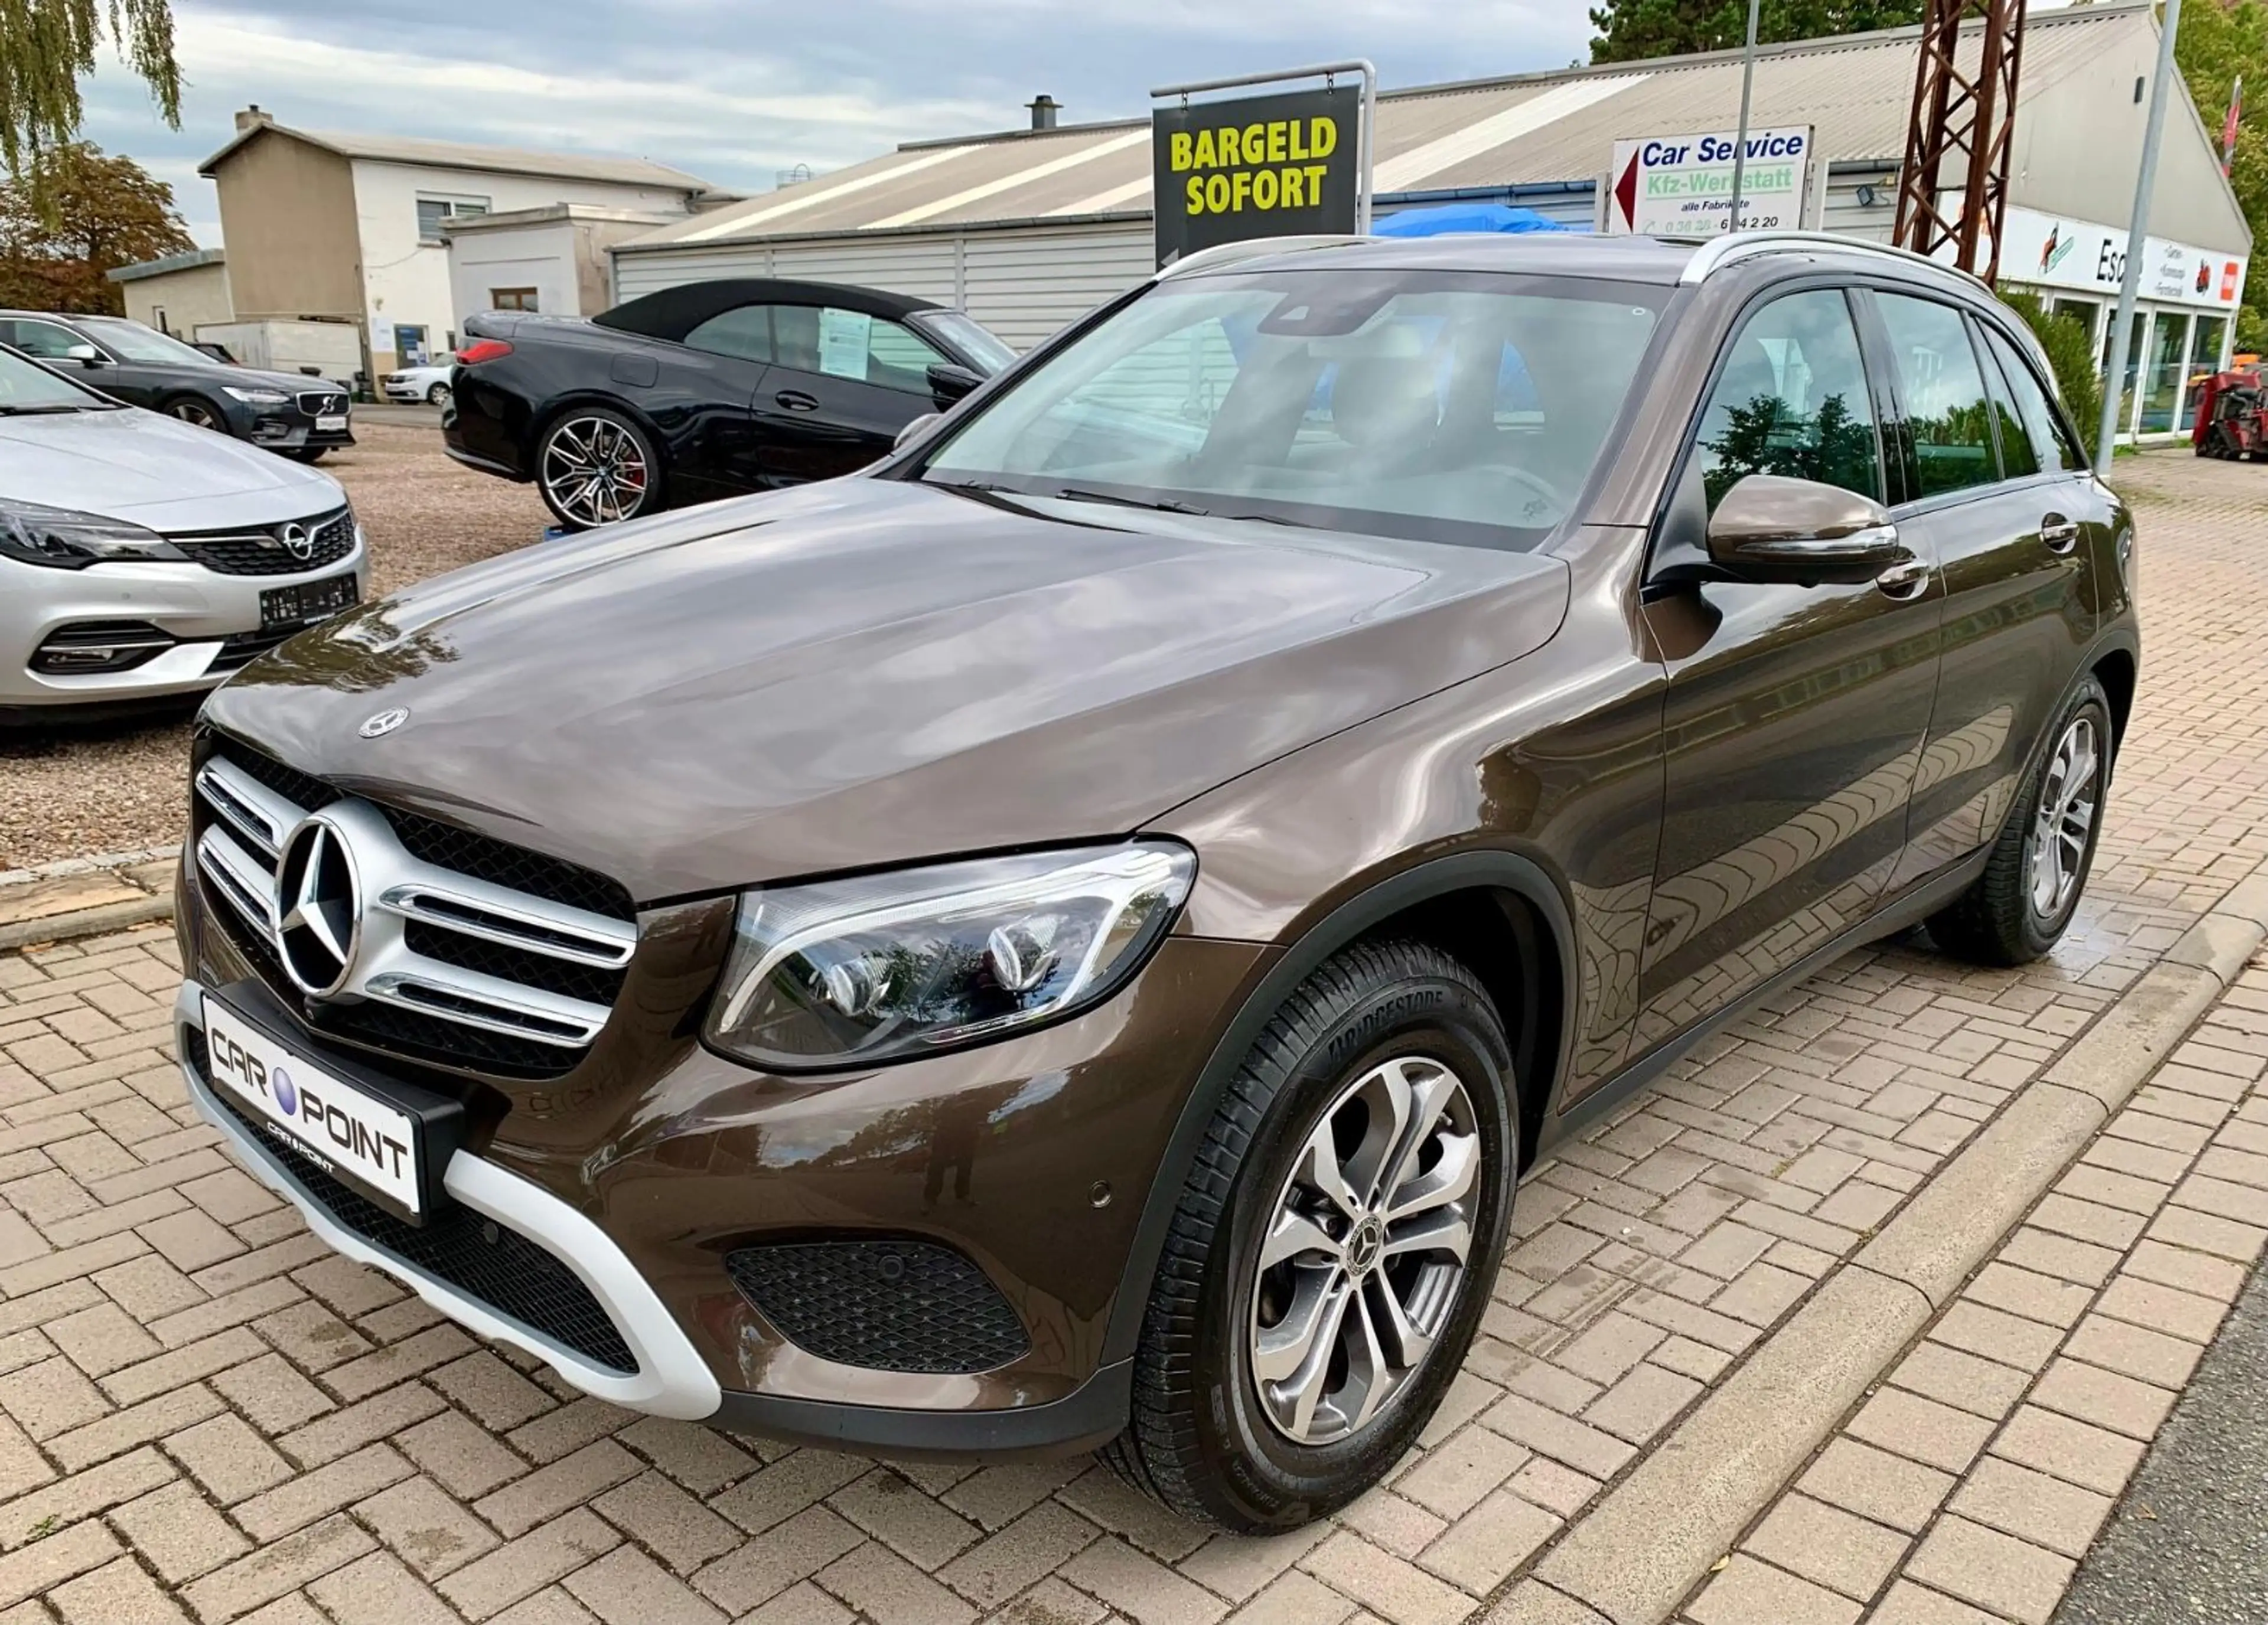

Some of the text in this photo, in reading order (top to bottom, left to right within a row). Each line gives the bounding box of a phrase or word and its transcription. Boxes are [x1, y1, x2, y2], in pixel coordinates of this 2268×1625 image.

[1171, 117, 1337, 171] BARGELD
[1643, 142, 1690, 167] Car
[1187, 165, 1327, 215] SOFORT
[1702, 200, 1750, 211] Fabrikte
[211, 1028, 408, 1180] CAR POINT
